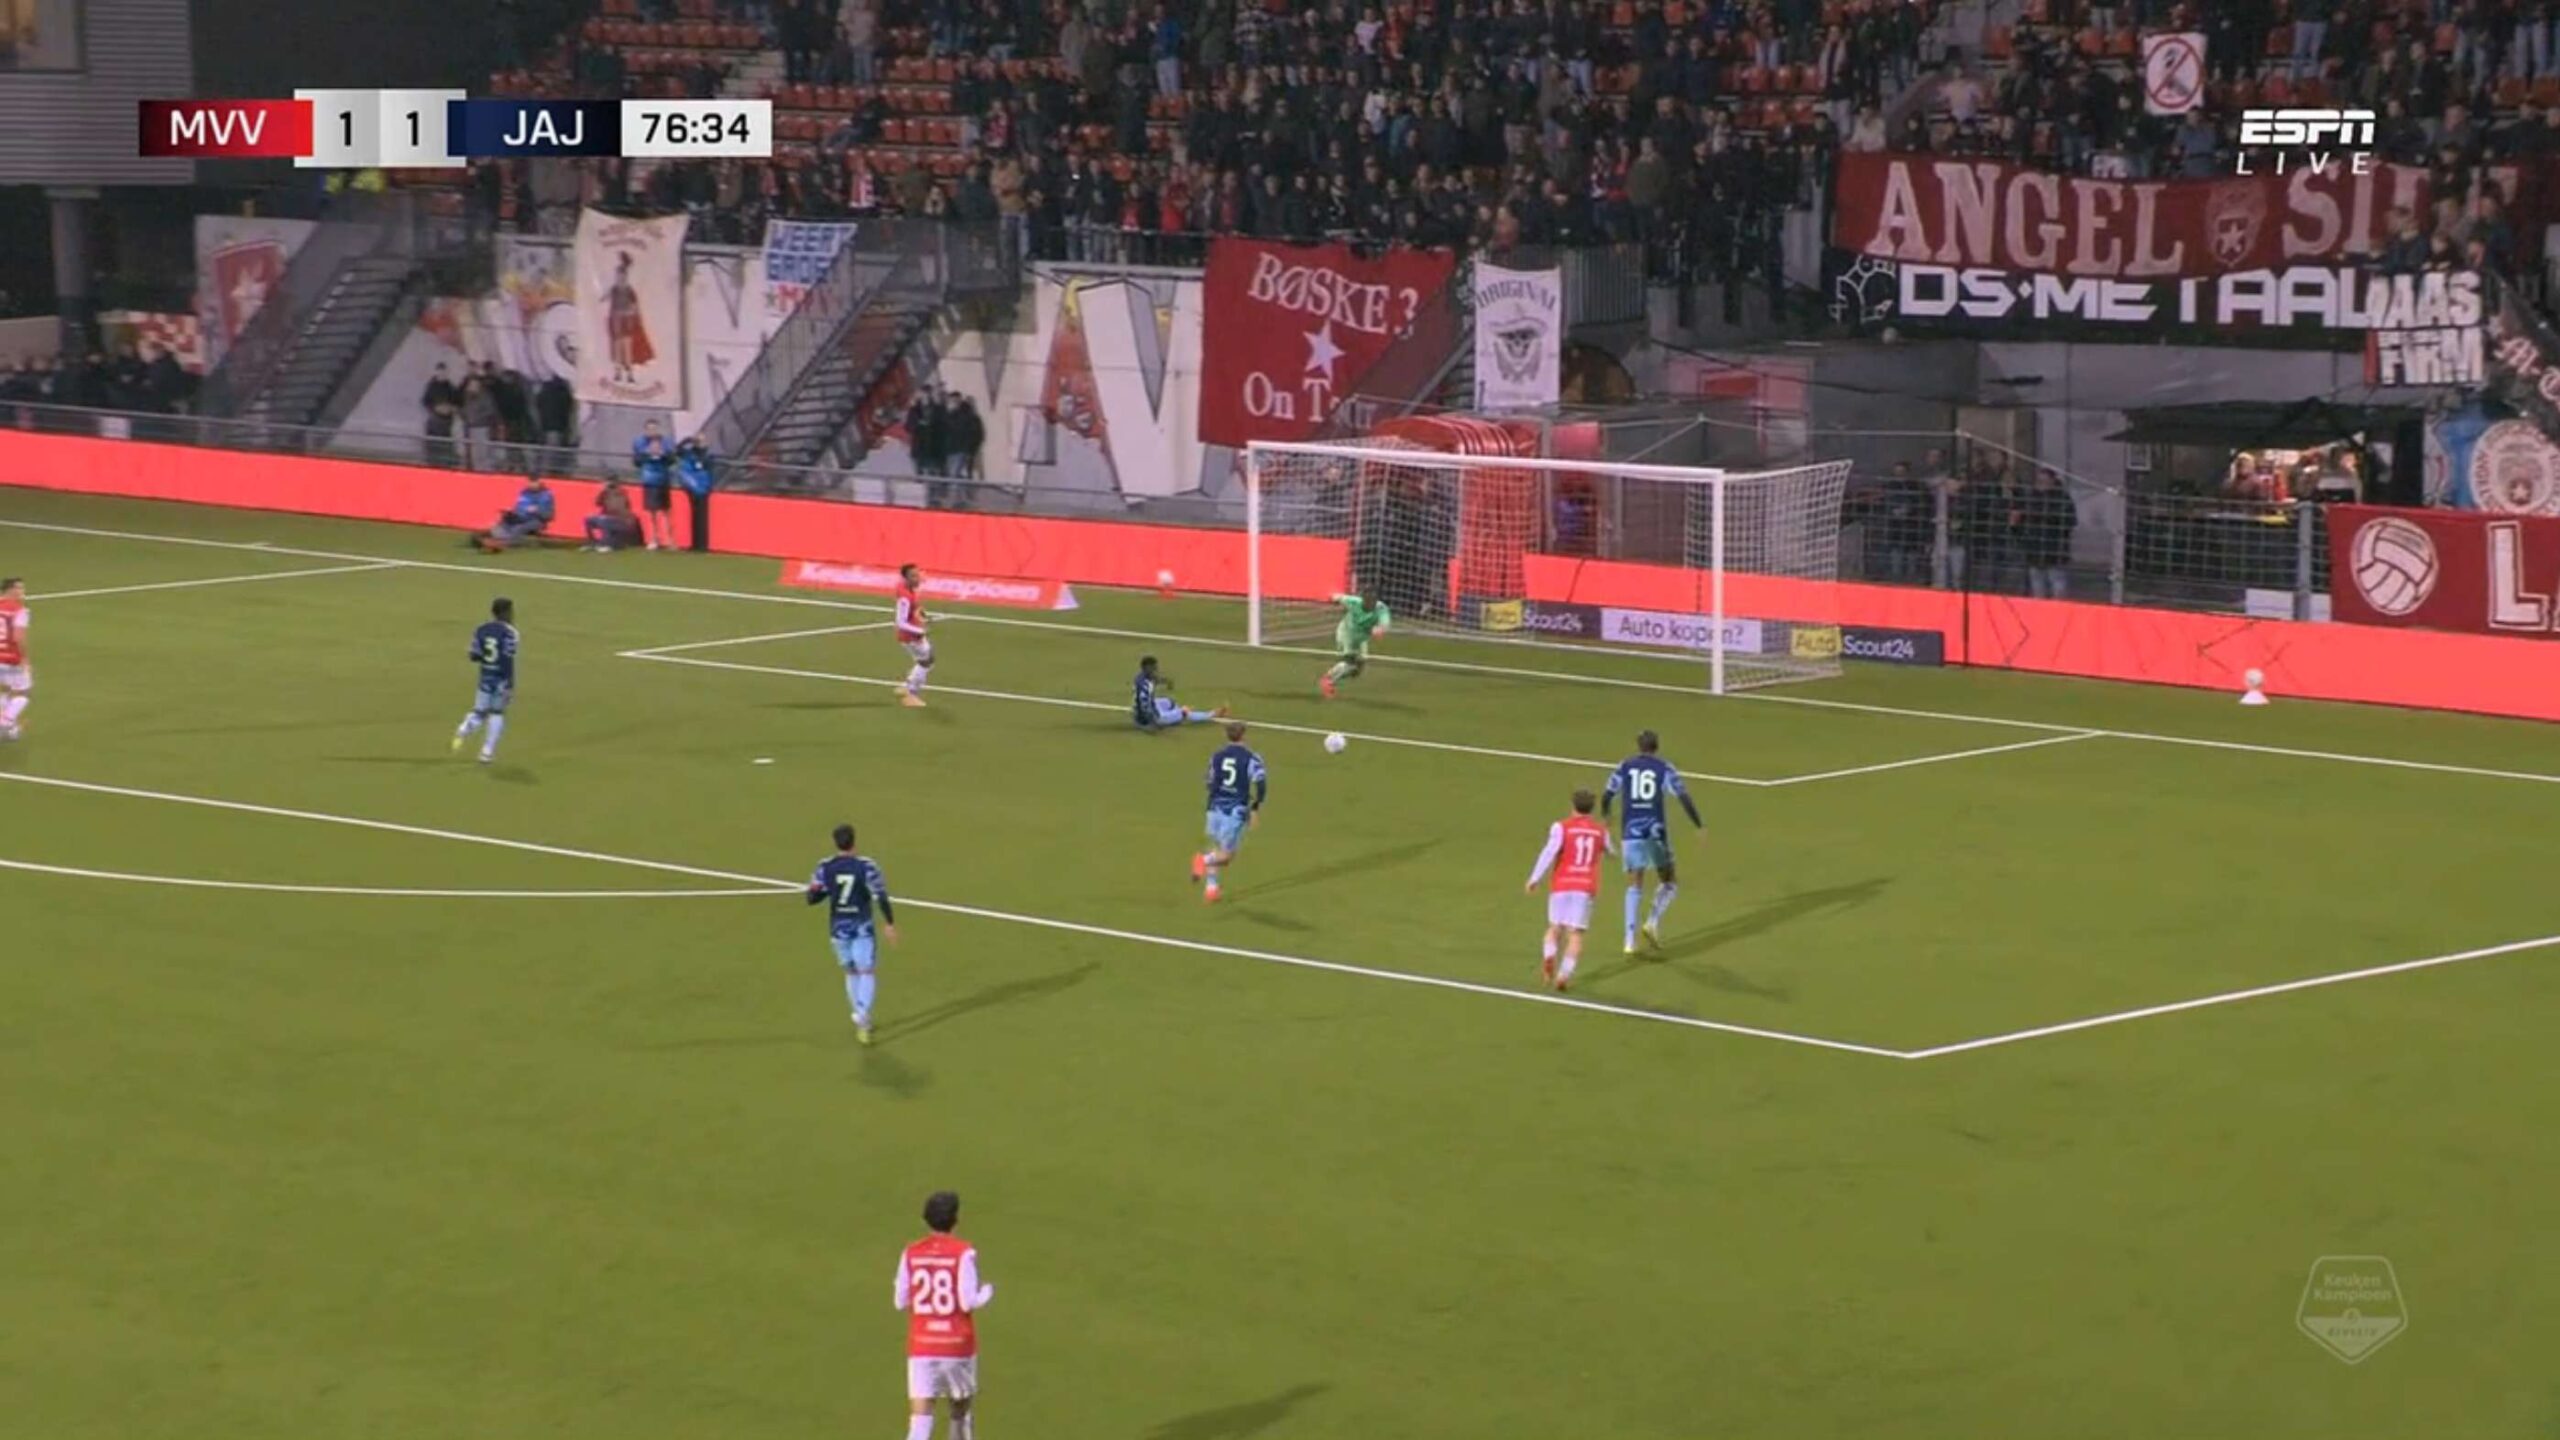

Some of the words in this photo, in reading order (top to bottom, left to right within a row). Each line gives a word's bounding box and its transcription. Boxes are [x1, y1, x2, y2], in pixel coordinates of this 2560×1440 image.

[1864, 161, 2184, 276] ANGEL
[1248, 252, 1389, 334] BØSKE
[1242, 371, 1295, 420] On
[1619, 616, 1665, 638] Auto
[484, 637, 498, 662] 3
[1843, 634, 1914, 659] Scout24
[1221, 758, 1237, 786] 5
[1629, 769, 1656, 799] 16
[1574, 836, 1595, 865] 11
[836, 874, 855, 904] 7
[911, 1268, 955, 1316] 28
